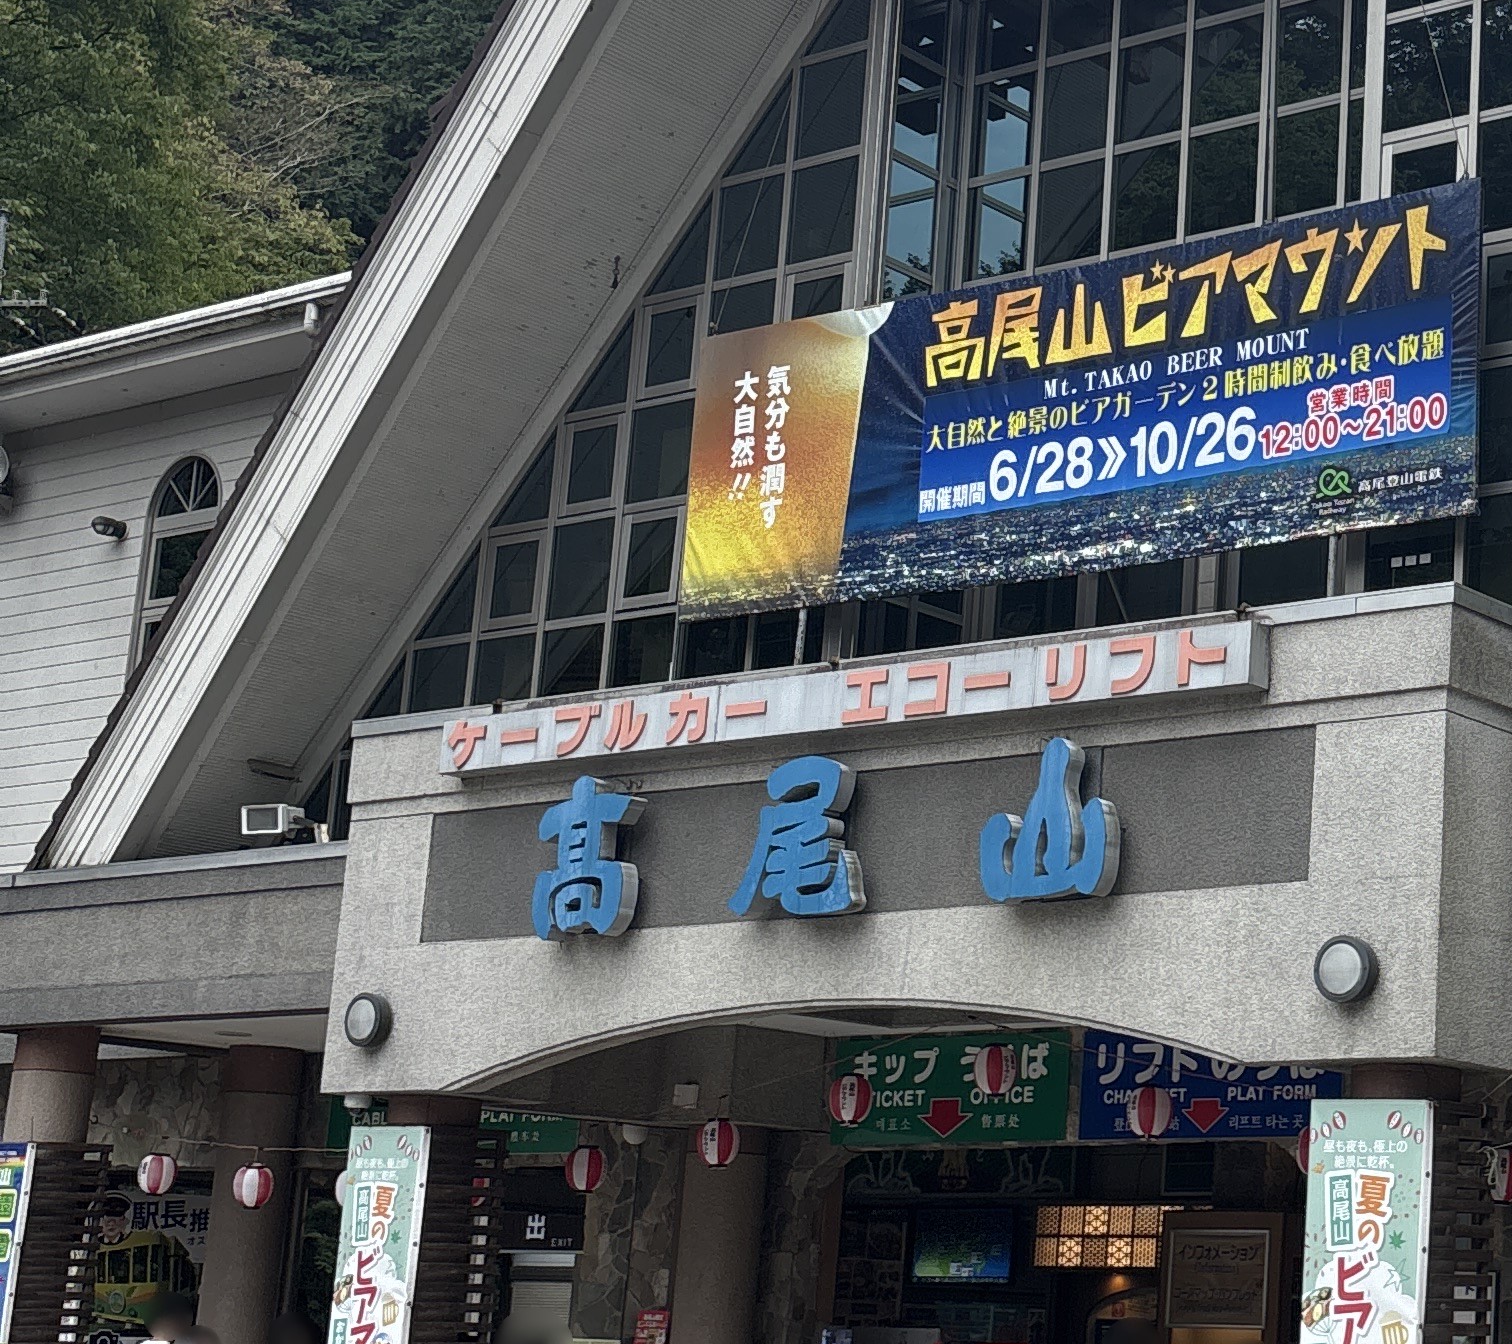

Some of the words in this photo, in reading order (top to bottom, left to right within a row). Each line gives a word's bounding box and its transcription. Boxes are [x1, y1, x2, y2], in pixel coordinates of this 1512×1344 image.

[925, 205, 1448, 387] 高尾山ビアマウント
[1043, 379, 1077, 400] Mt.
[1085, 361, 1152, 391] TAKAO
[1167, 347, 1222, 375] BEER
[1236, 328, 1309, 362] MOUNT
[1309, 377, 1393, 414] 営業時間
[760, 365, 791, 528] 気分も潤す
[919, 481, 986, 514] 開催期間
[447, 688, 768, 771] ケーブルカー
[841, 630, 1232, 725] エコーリフト
[351, 1111, 388, 1126] CABL
[872, 1090, 926, 1107] ICKET
[970, 1086, 1034, 1104] OICE
[1227, 1087, 1271, 1102] PLAT
[1273, 1085, 1317, 1100] FORM
[371, 1186, 395, 1240] 夏の
[1332, 1179, 1350, 1242] 高尾山
[1355, 1174, 1390, 1244] 夏の
[551, 1238, 573, 1247] EXIT
